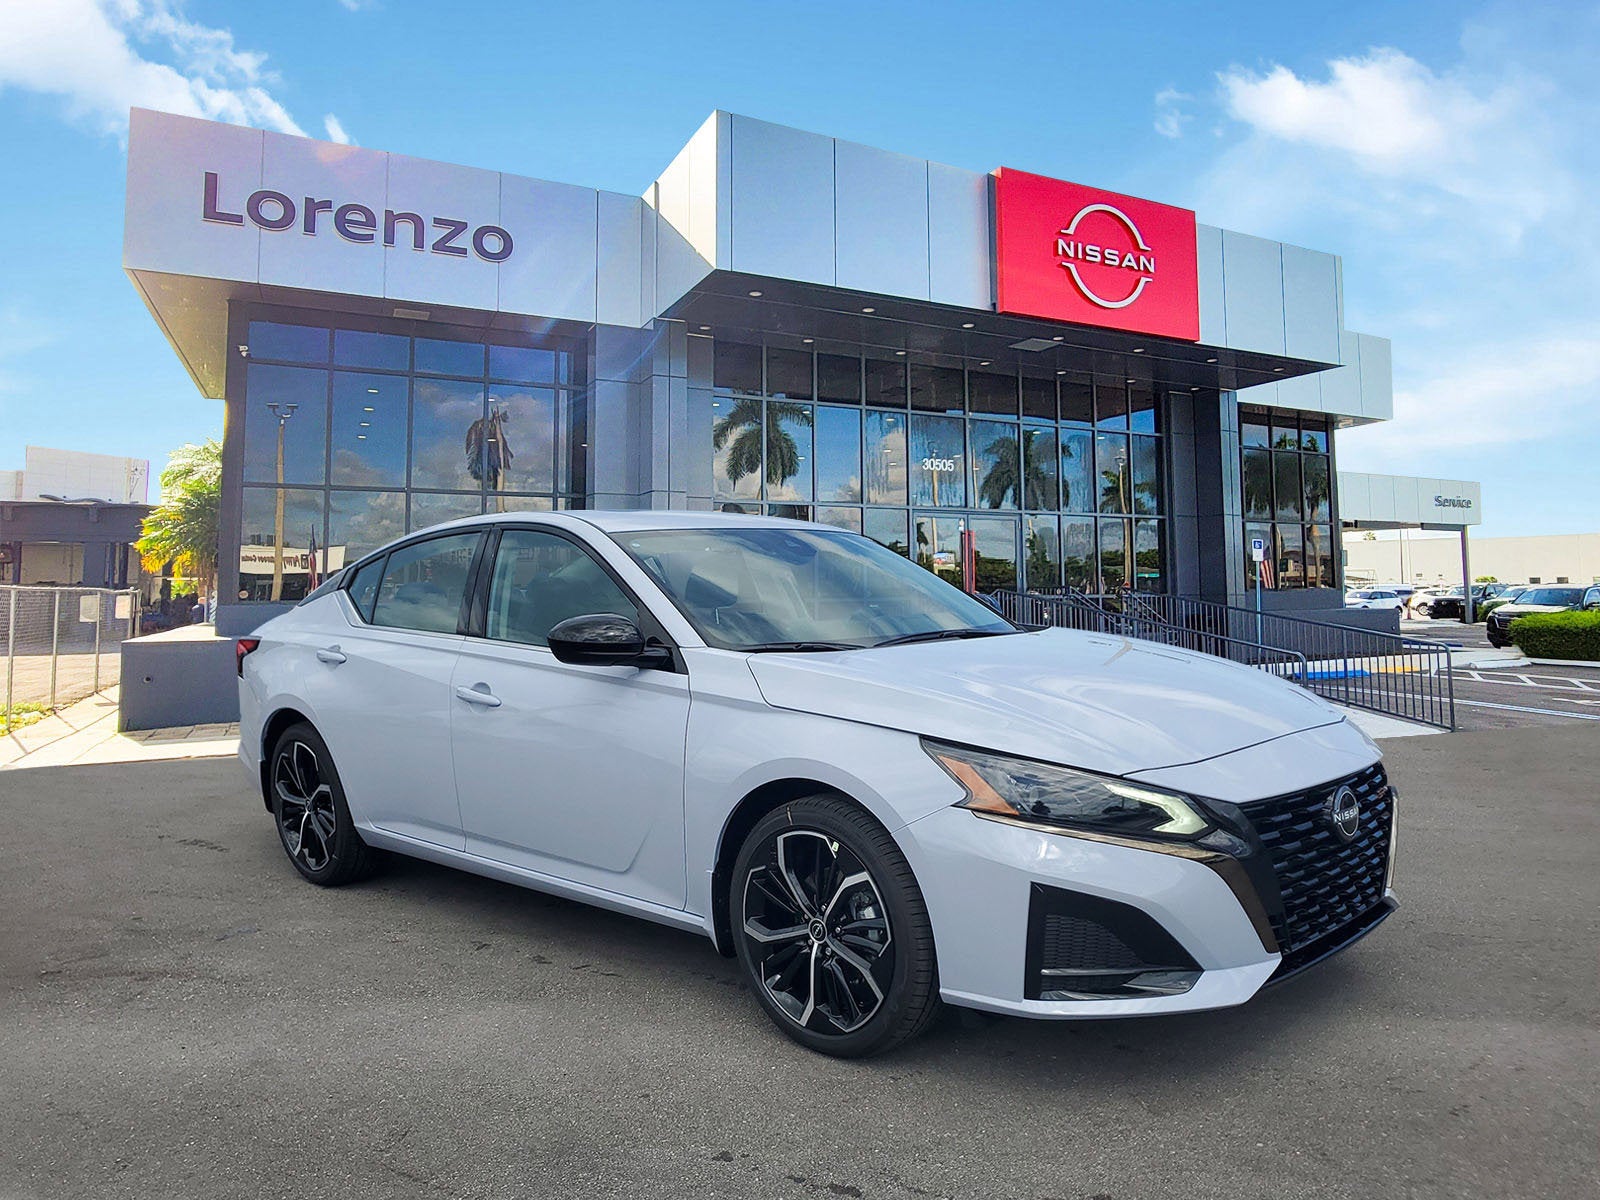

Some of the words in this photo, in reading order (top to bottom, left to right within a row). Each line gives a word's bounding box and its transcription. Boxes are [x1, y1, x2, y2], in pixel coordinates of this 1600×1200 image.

[202, 171, 514, 262] Lorenzo
[1058, 238, 1155, 273] NISSAN
[922, 457, 954, 472] 30505
[1434, 495, 1472, 508] Service
